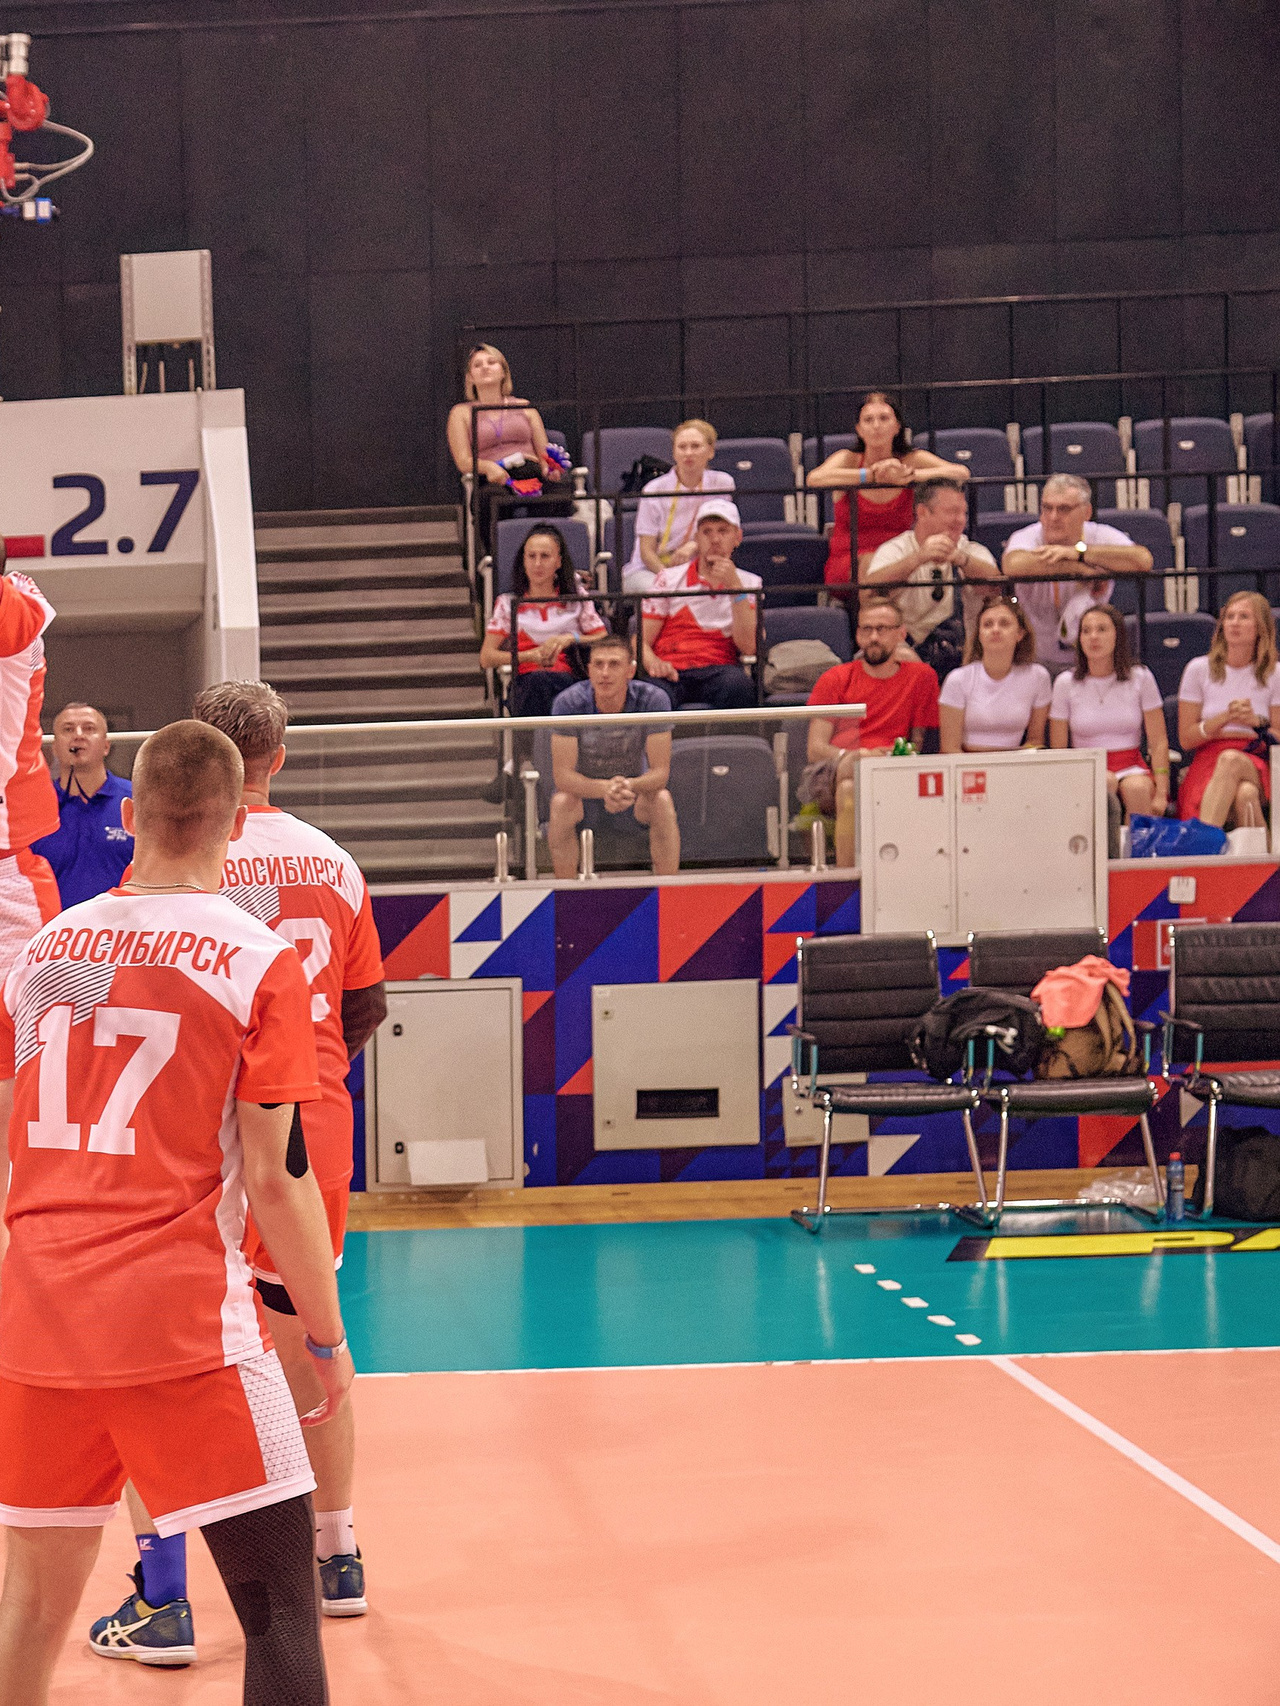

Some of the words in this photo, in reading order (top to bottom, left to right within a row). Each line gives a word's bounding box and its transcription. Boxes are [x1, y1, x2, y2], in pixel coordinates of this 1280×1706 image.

[50, 469, 200, 557] 2.7
[27, 927, 242, 980] НОВОСИБИРСК
[26, 1004, 182, 1156] 17
